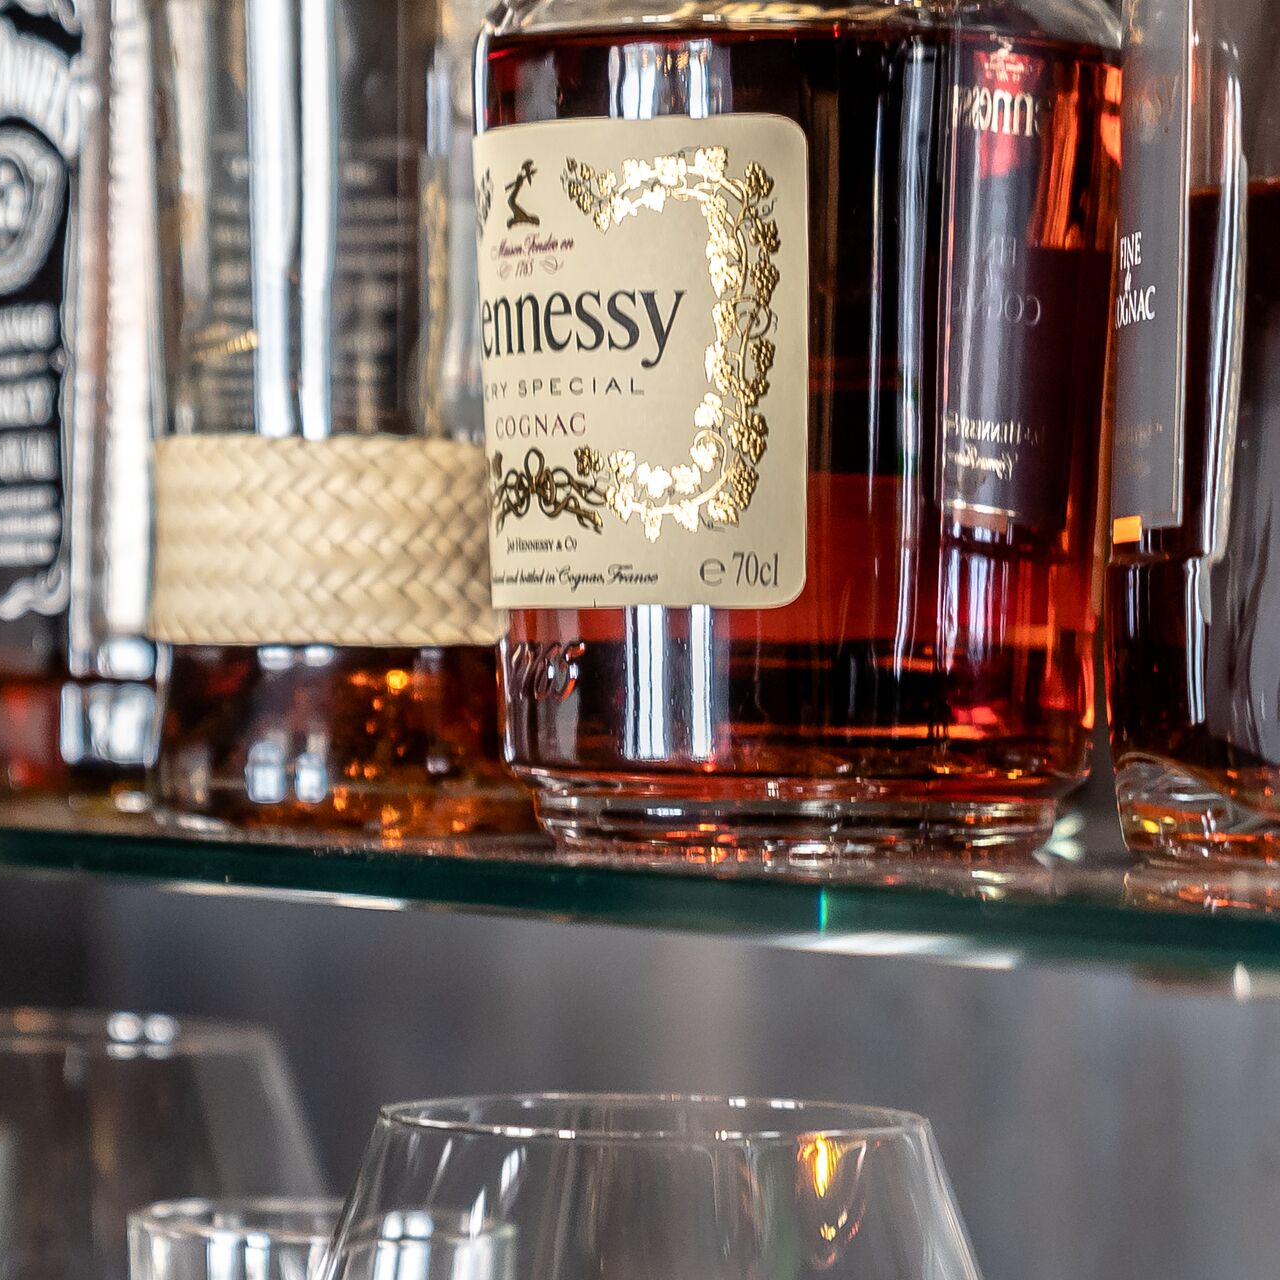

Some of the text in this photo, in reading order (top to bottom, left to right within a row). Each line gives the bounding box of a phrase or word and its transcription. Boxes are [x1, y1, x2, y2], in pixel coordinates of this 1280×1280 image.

[1115, 285, 1156, 330] OGNAC
[481, 288, 688, 370] ennessy
[518, 376, 645, 397] SPECIAL
[495, 412, 587, 441] COGNAC
[732, 551, 779, 587] 70cl
